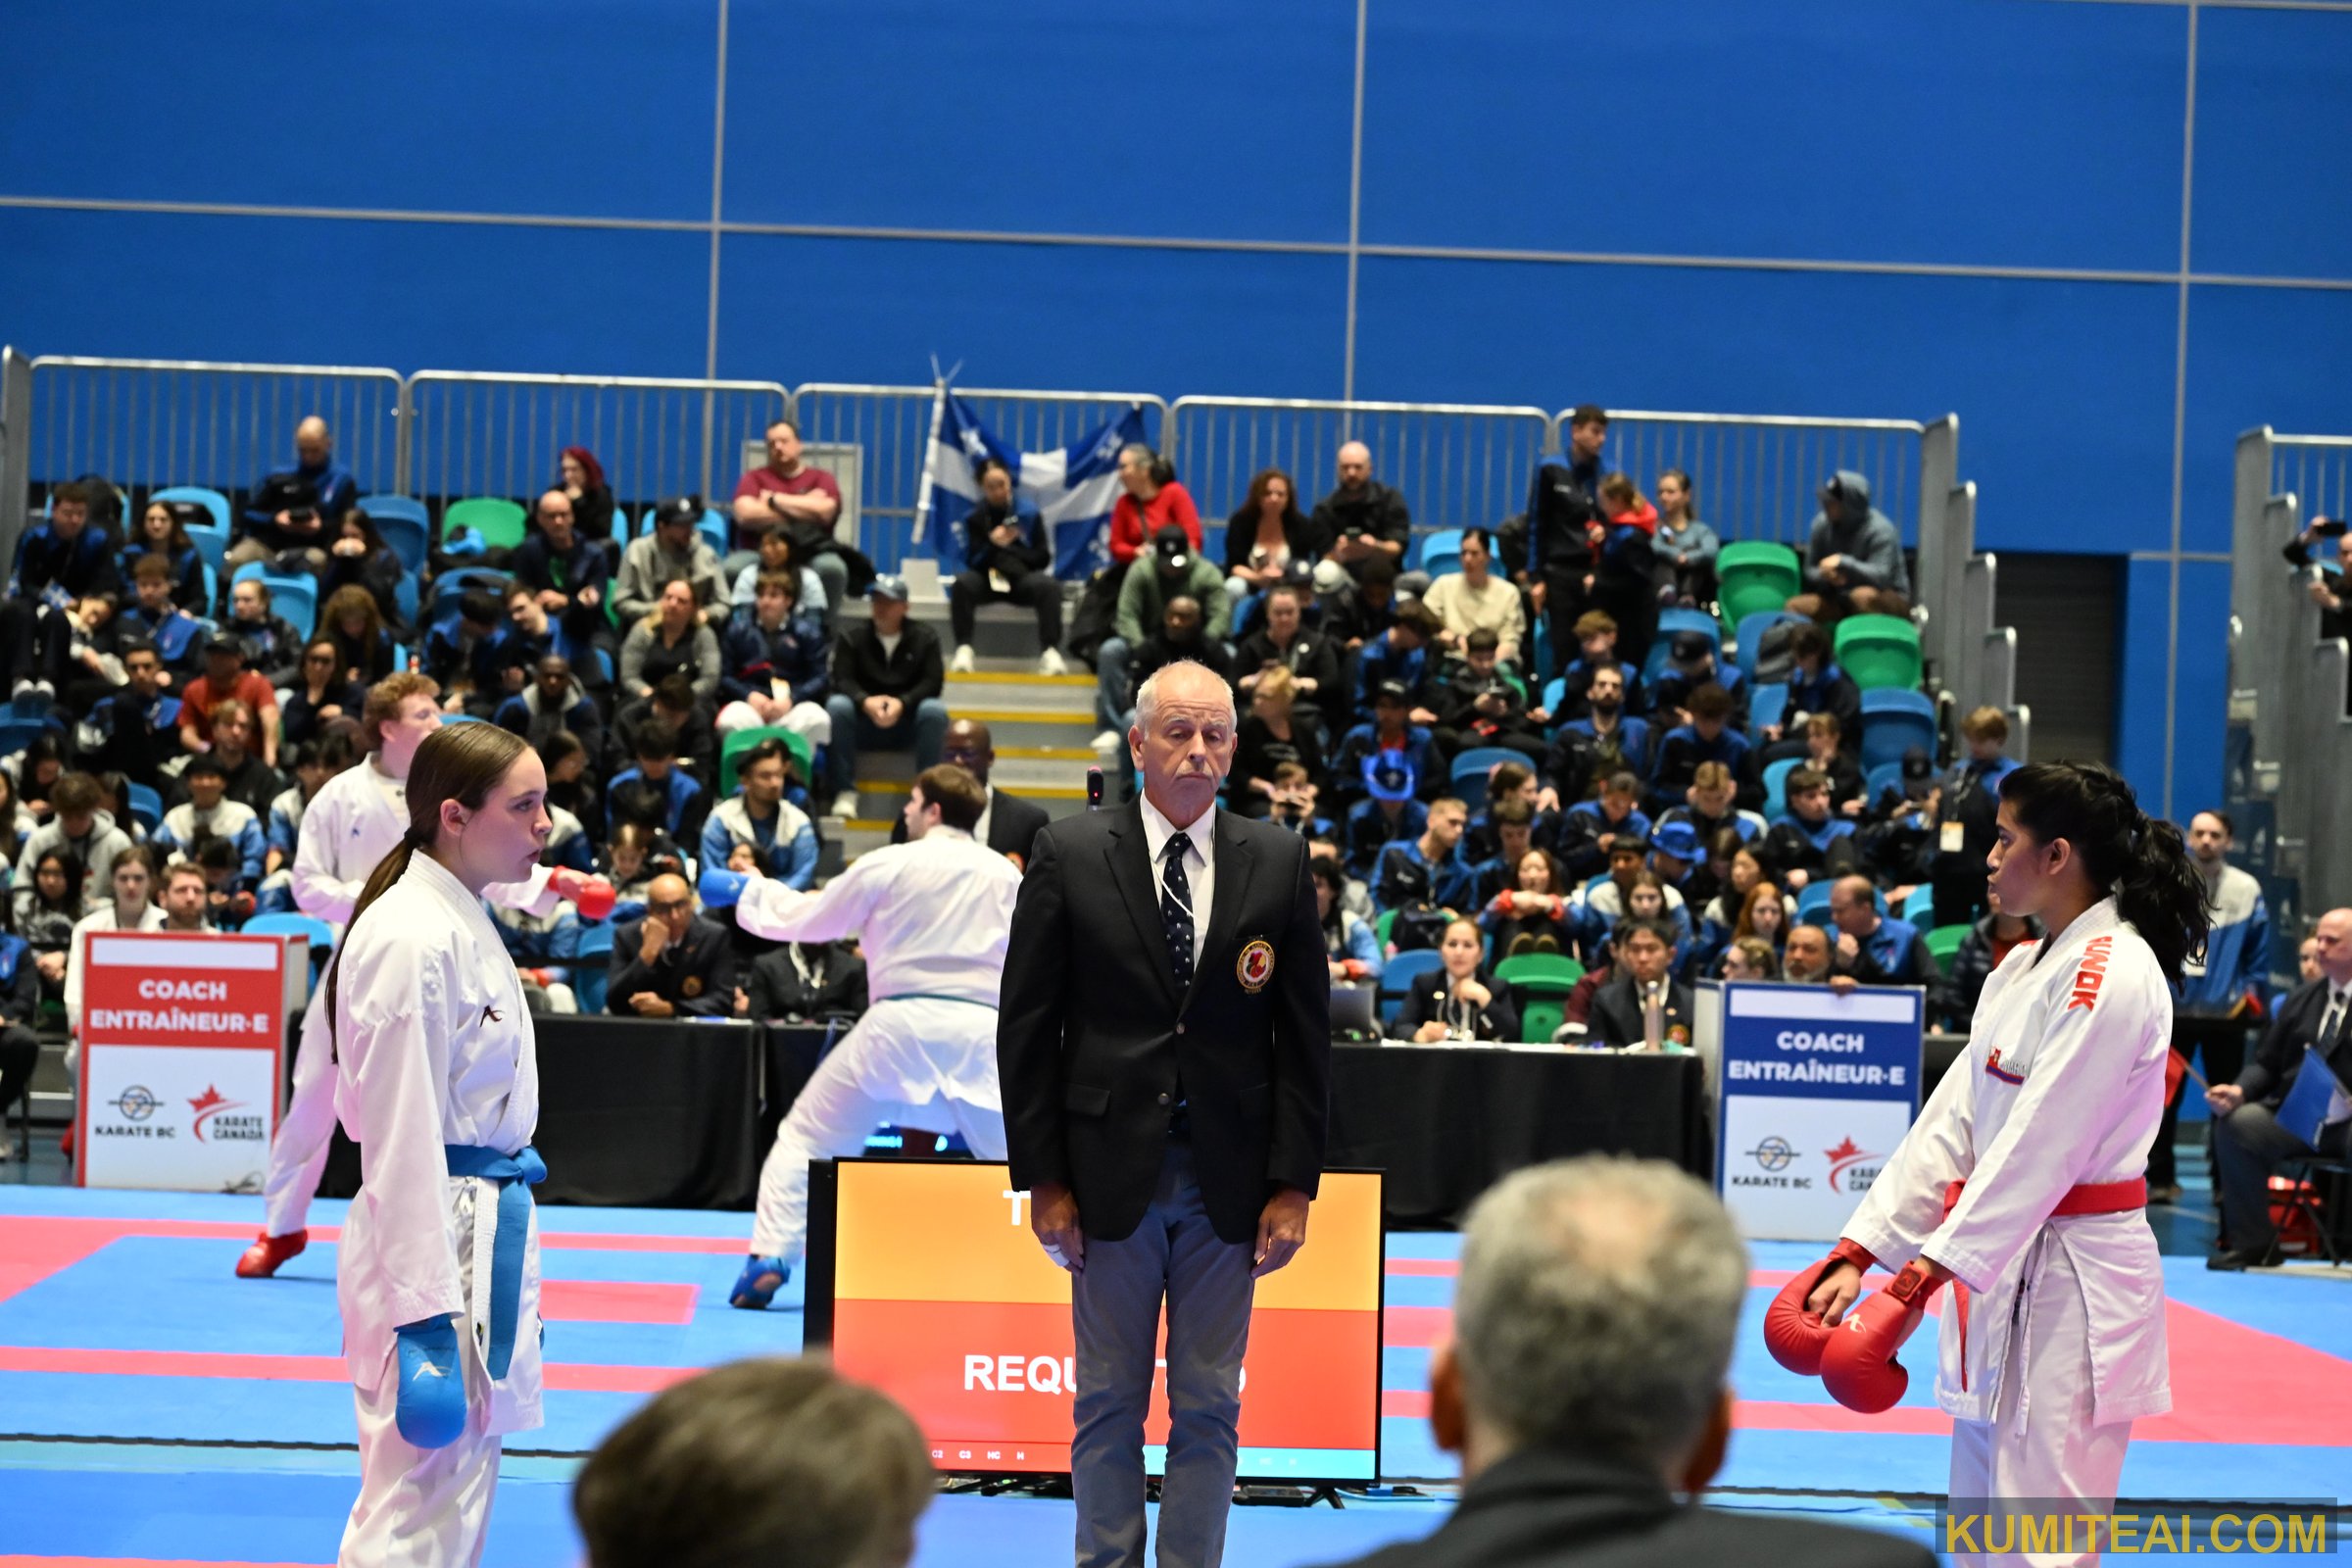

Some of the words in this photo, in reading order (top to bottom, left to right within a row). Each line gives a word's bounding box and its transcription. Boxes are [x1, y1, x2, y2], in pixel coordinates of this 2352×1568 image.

[138, 979, 227, 1001] COACH
[1777, 1031, 1864, 1053] COACH
[214, 1116, 264, 1128] KARATE
[95, 1125, 152, 1137] KARATE
[156, 1126, 175, 1138] BC
[214, 1129, 265, 1140] CANADA
[1732, 1176, 1788, 1188] KARATE
[1792, 1177, 1812, 1189] BC
[987, 1450, 1001, 1459] HC
